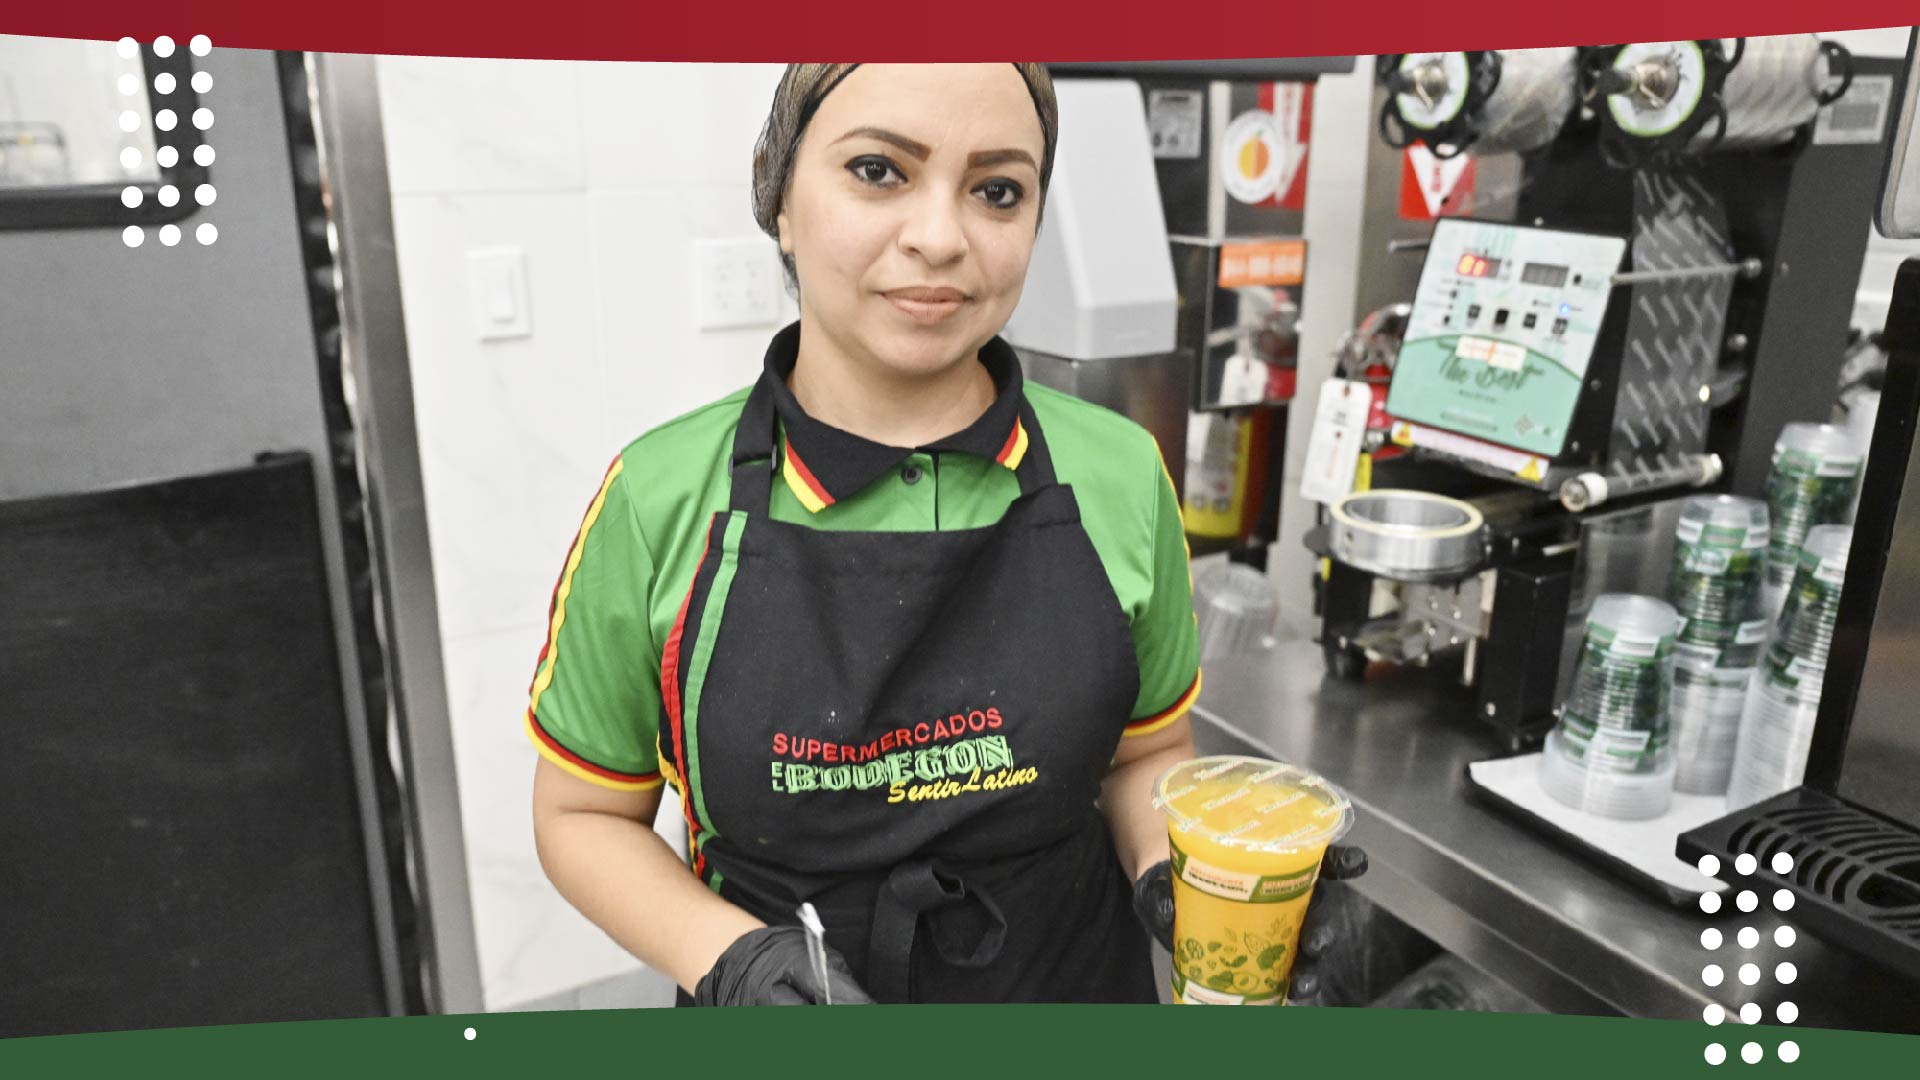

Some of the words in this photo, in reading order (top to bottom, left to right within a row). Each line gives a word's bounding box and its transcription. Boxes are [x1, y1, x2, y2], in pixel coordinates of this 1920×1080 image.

[772, 707, 1004, 763] SUPERMERCADOS
[785, 735, 1014, 794] BODEGON
[888, 779, 962, 803] Sentir
[961, 764, 1038, 793] Latino
